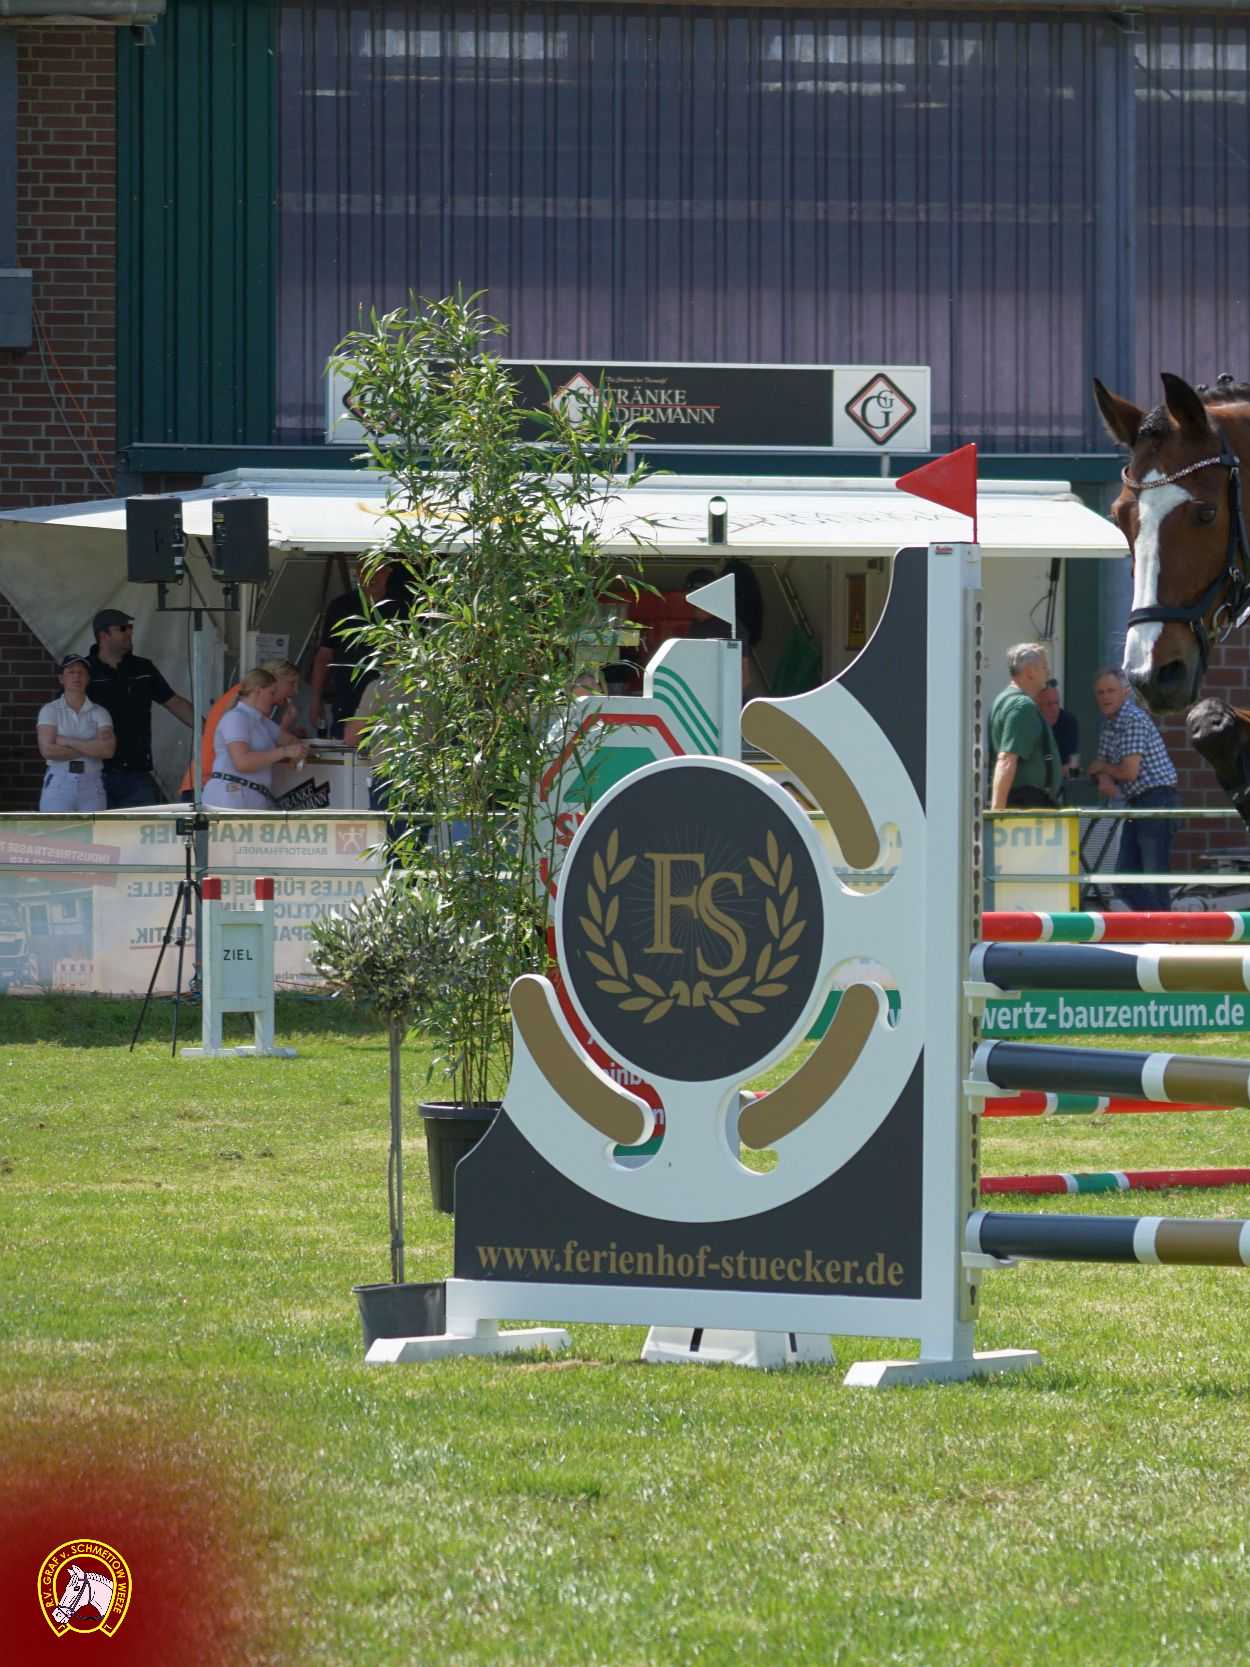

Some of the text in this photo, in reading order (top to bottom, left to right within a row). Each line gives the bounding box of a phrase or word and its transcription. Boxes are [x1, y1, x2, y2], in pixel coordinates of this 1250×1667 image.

[643, 852, 748, 977] FS
[223, 948, 254, 961] ZIEL
[476, 1240, 905, 1287] www.ferienhof-stuecker.de
